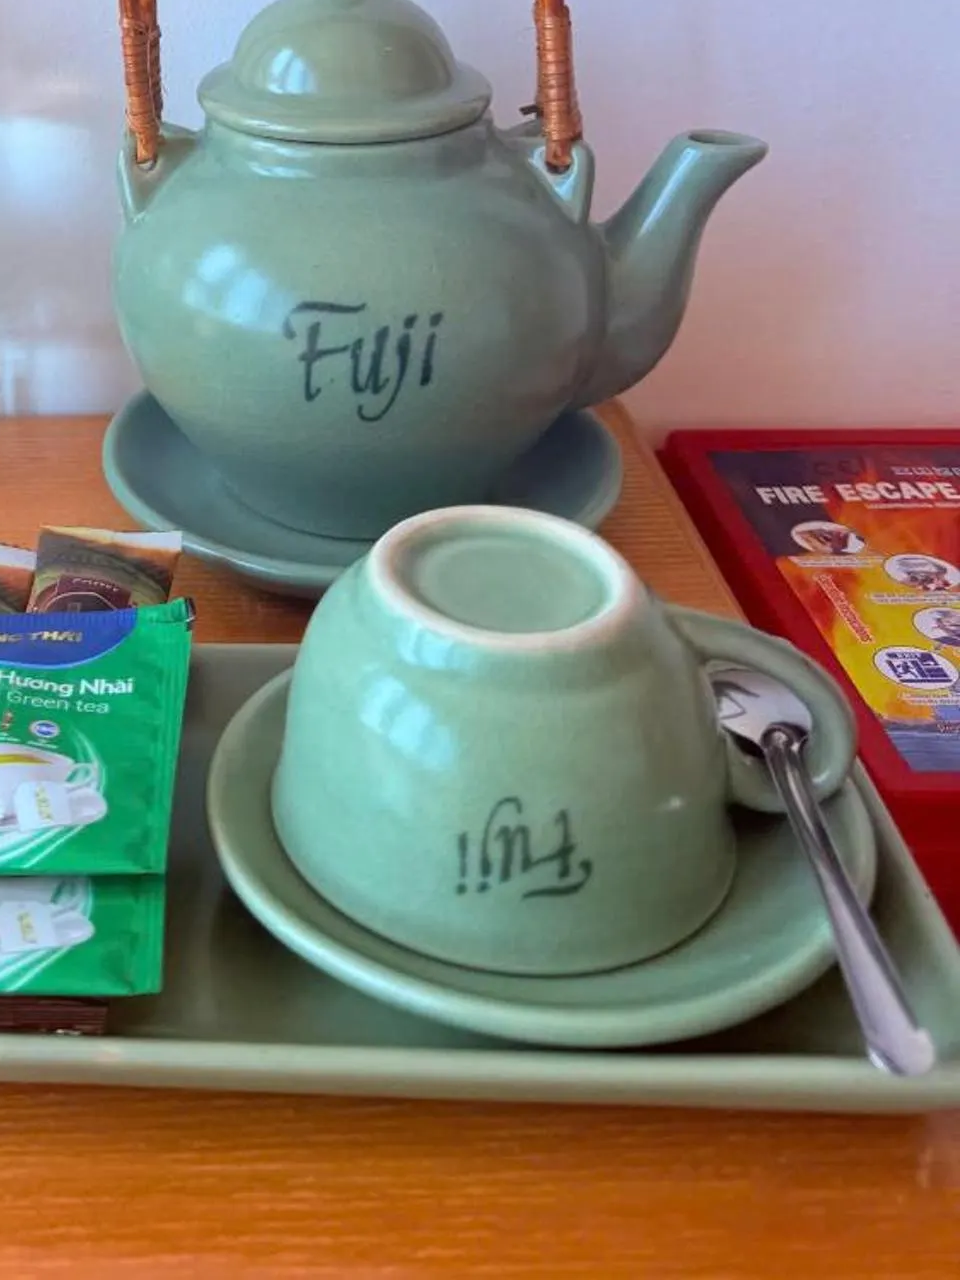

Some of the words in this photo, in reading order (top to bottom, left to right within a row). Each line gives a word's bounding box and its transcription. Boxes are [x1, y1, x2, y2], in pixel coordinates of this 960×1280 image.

[282, 300, 445, 422] Fuji
[754, 485, 830, 505] FIRE
[835, 481, 960, 502] ESCAPE
[6, 690, 70, 712] Green
[75, 700, 110, 714] tea
